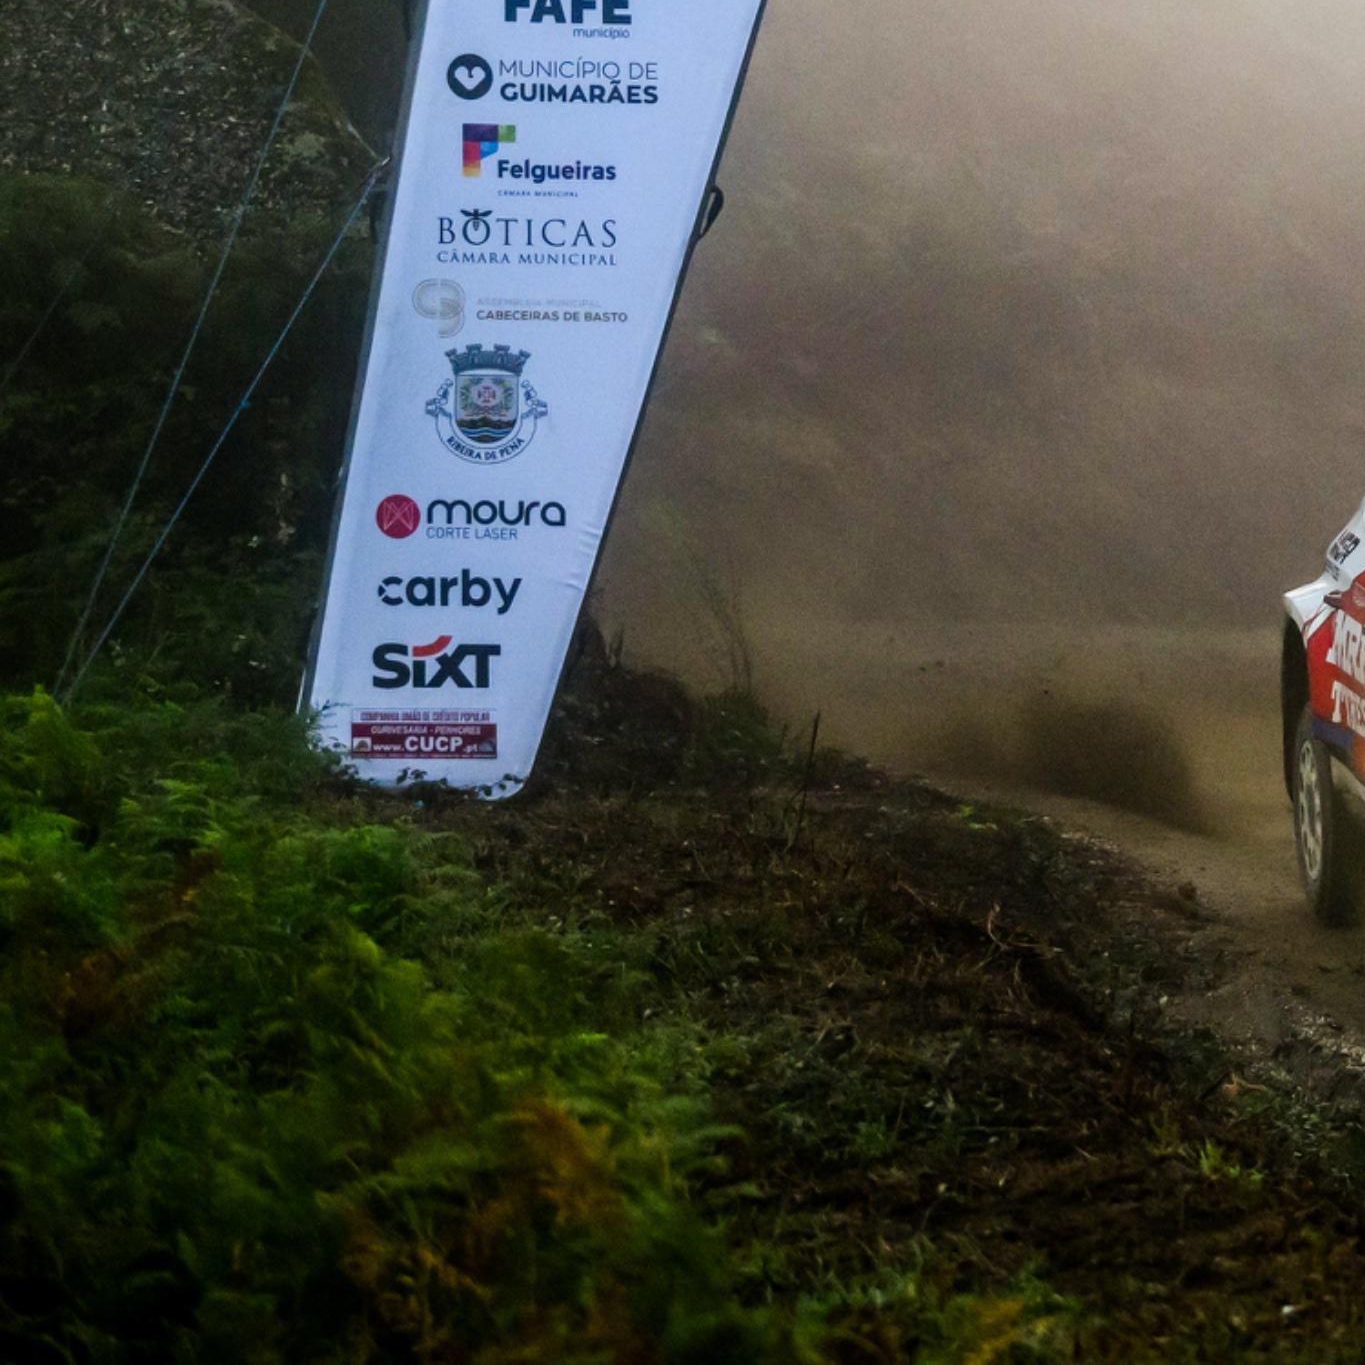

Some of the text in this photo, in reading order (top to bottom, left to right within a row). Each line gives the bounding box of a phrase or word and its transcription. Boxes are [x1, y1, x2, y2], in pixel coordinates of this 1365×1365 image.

[500, 56, 658, 80] MUNICÍPIO DE
[500, 79, 659, 104] GUIMARÃES
[497, 159, 616, 184] Felgueiras
[438, 216, 617, 248] BOTICAS
[437, 248, 616, 266] CÂMARA MUNICIPAL
[476, 310, 628, 323] CABECEIRAS DE BASTO
[446, 436, 526, 461] RIBEIRA DE PENA
[427, 499, 566, 527] moura
[426, 526, 518, 540] CORTE LASER
[378, 569, 523, 615] carby
